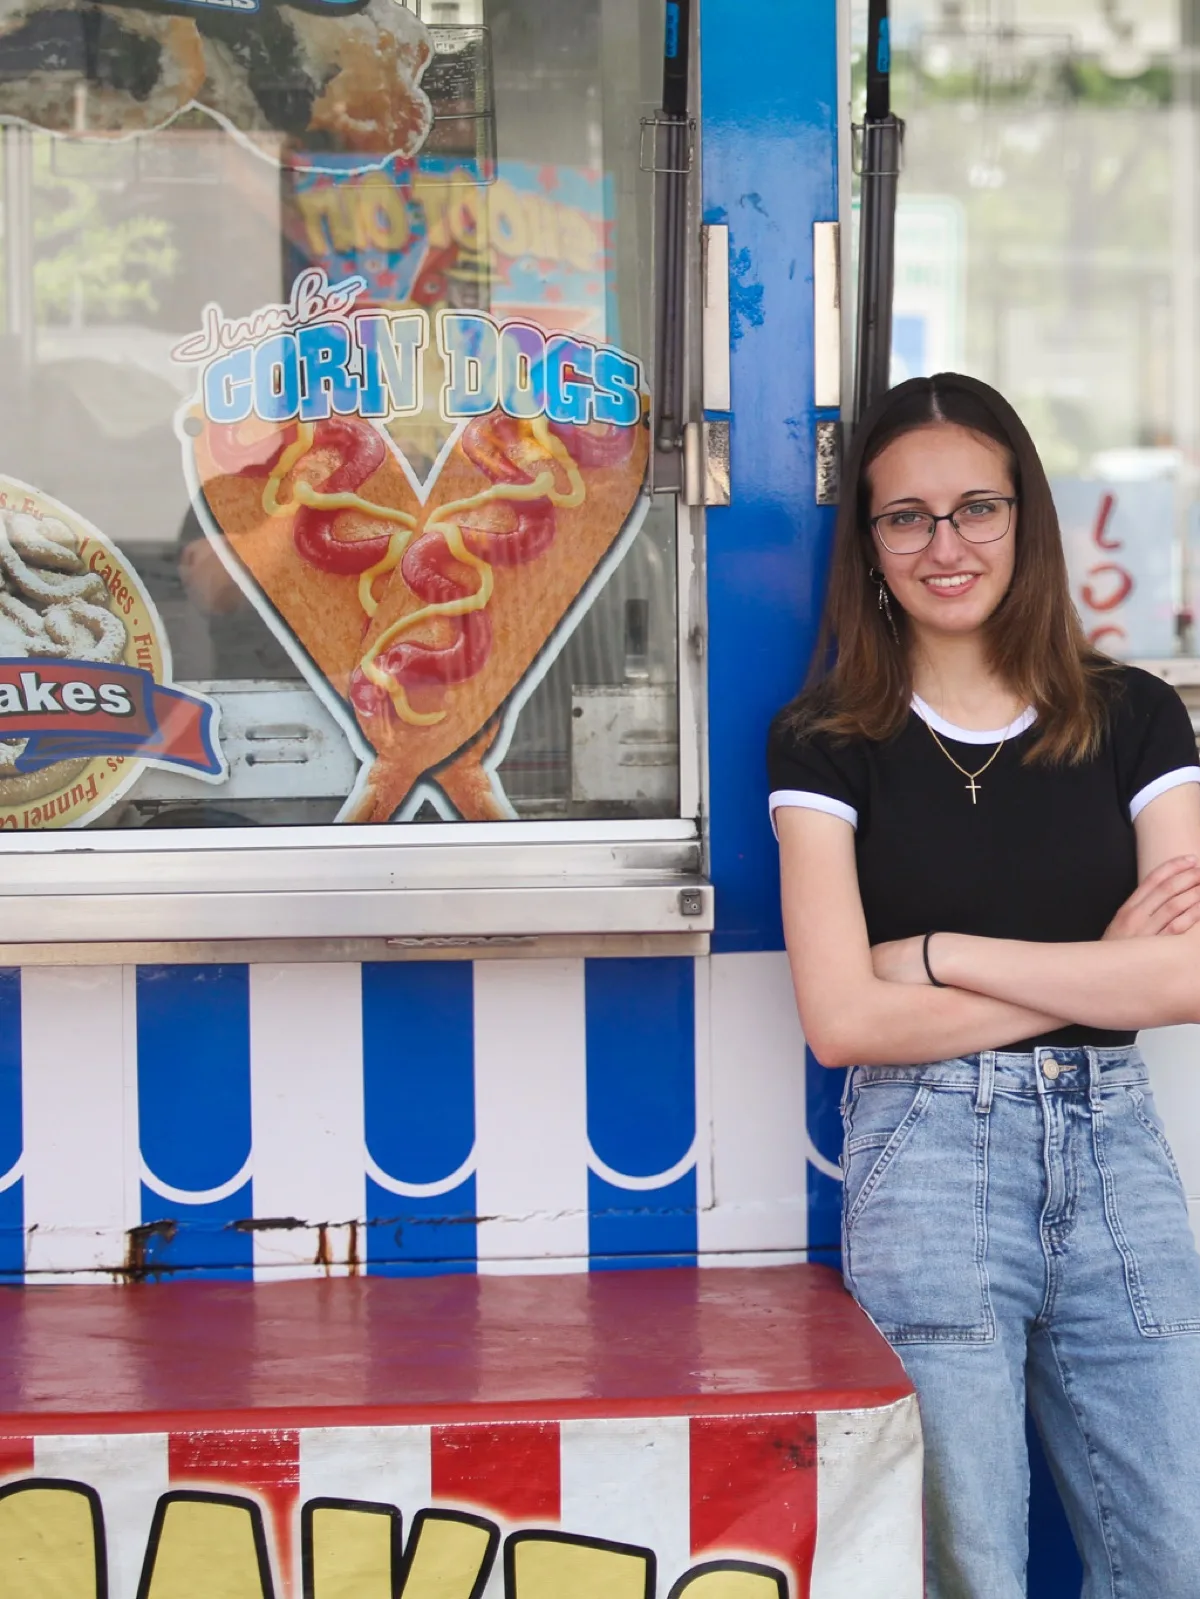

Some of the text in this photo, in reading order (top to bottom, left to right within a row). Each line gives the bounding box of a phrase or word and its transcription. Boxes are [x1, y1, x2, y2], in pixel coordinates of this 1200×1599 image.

[172, 269, 367, 362] Jumbo
[204, 312, 641, 426] CORN DOGS
[88, 550, 135, 615] Cakes
